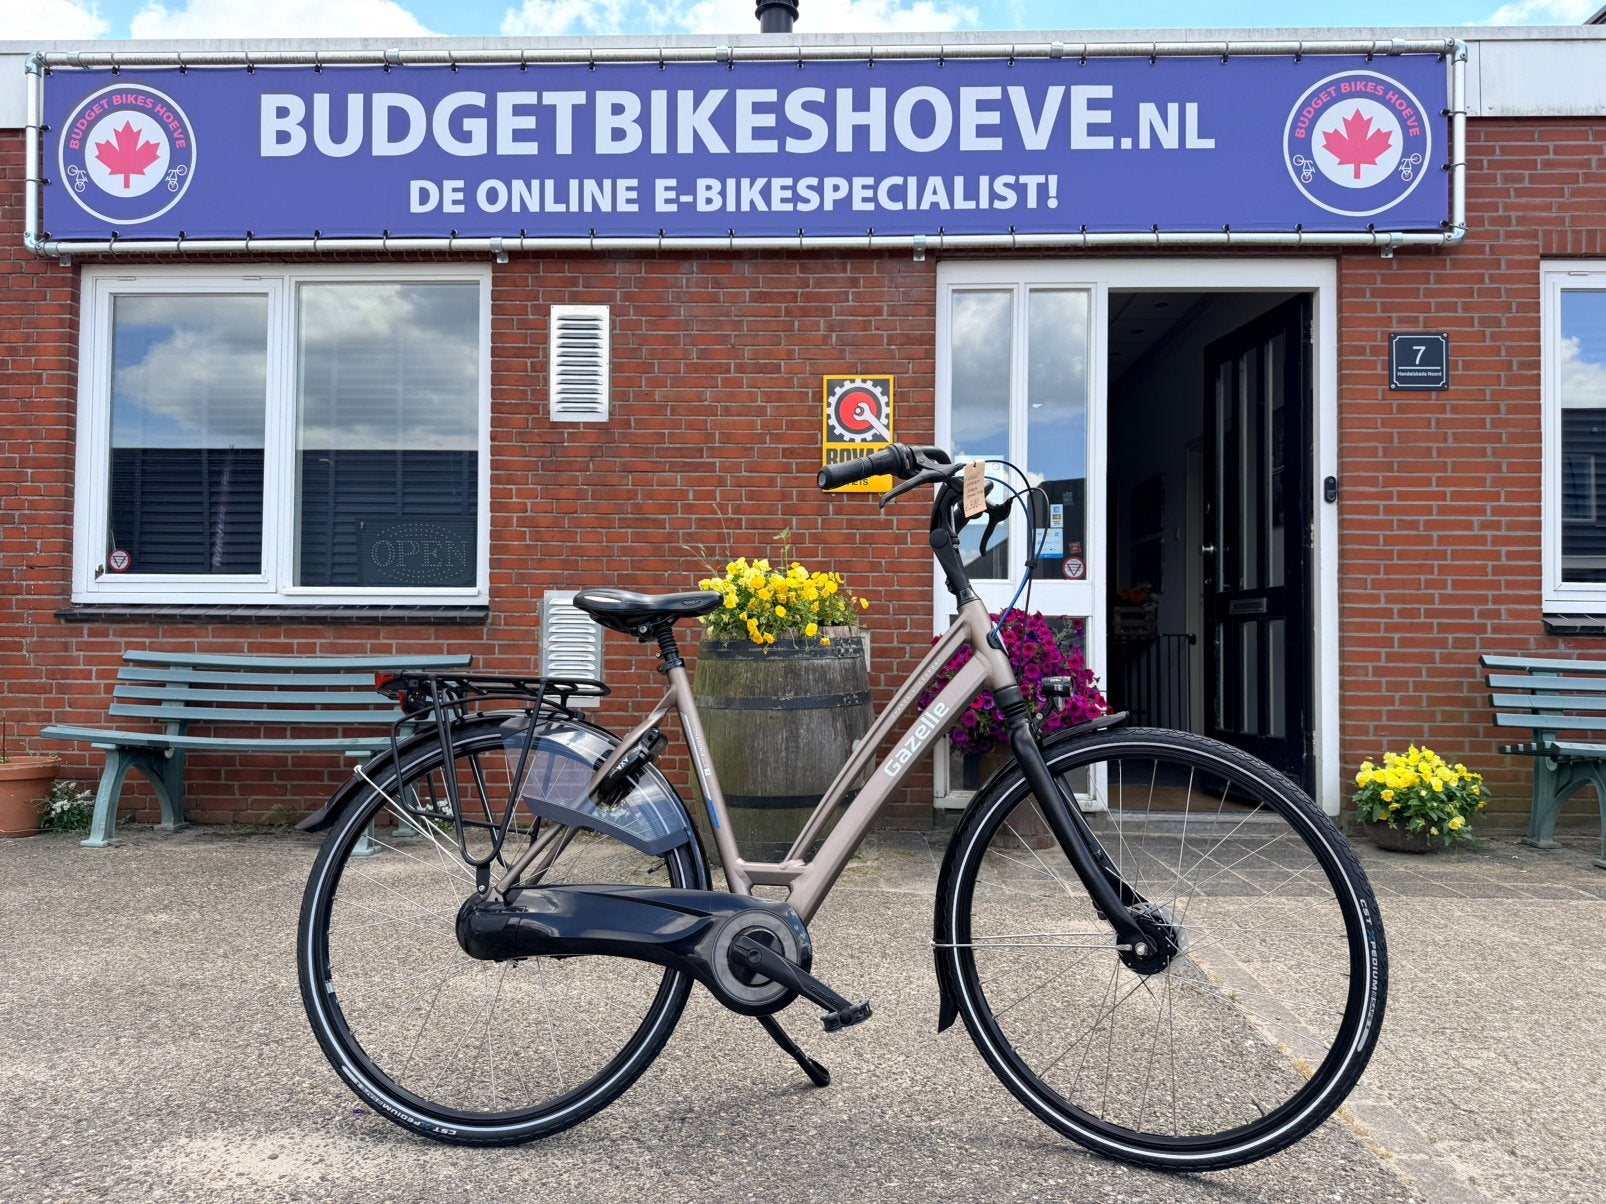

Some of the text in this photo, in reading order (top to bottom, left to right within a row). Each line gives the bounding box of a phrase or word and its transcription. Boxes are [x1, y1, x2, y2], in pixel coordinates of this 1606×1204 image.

[69, 94, 187, 149] BUDGET BIKES HOEVE
[260, 85, 1216, 158] BUDGETBIKESHOEVE.NL
[1295, 81, 1421, 139] BUDGET BIKES HOEVE
[410, 174, 1059, 213] DE ONLINE E-BIKESPECIALIST!
[1412, 345, 1426, 365] 7
[370, 540, 468, 567] OPEN
[883, 702, 949, 777] Gazelle
[1360, 898, 1373, 926] CST
[433, 1125, 458, 1136] CST
